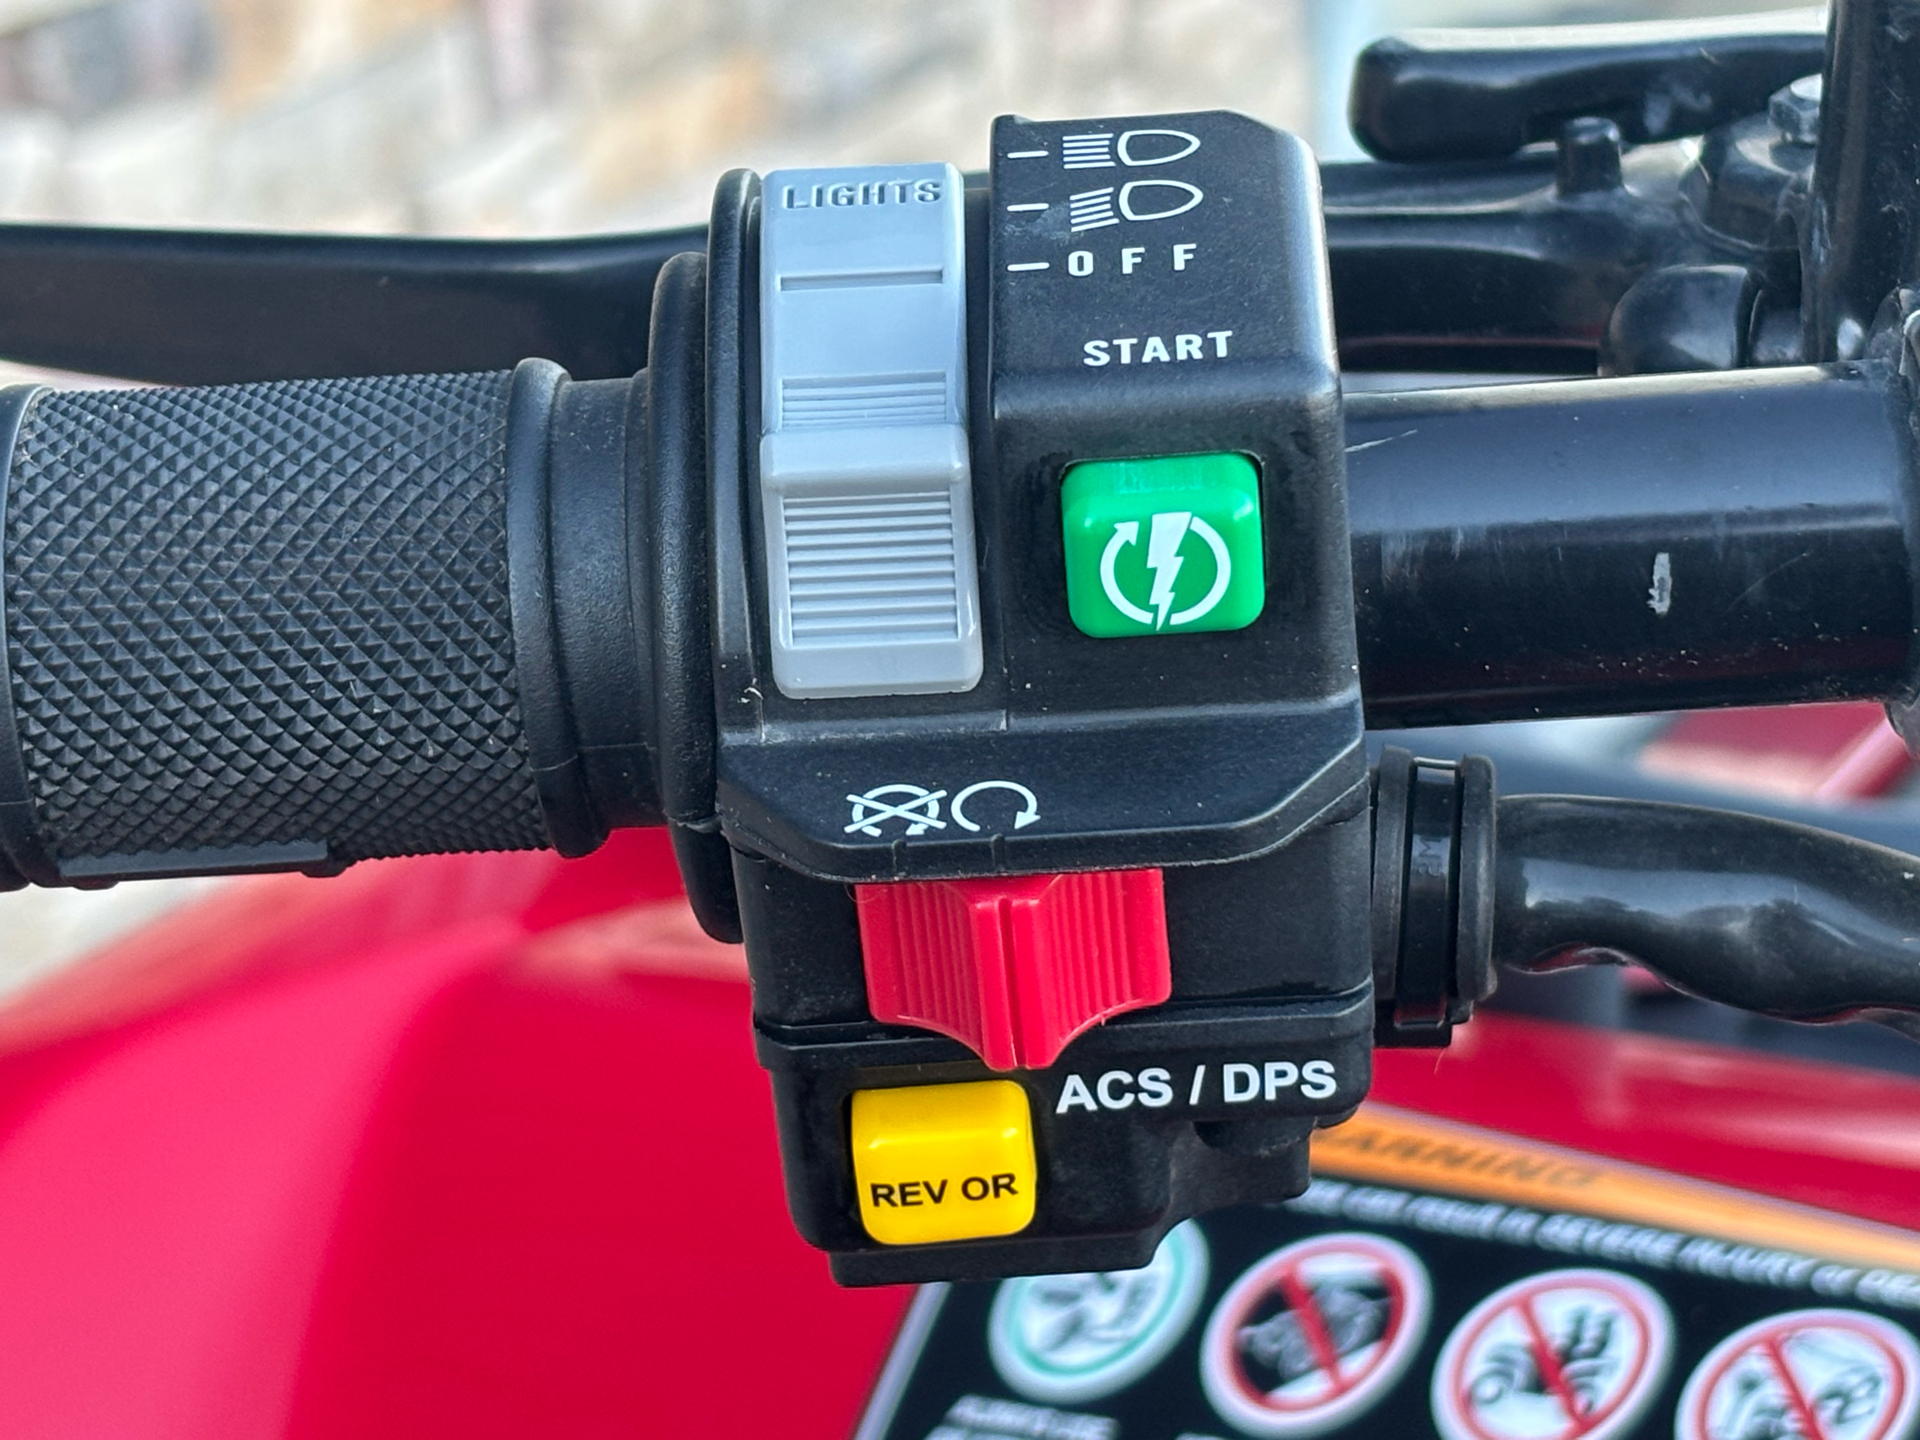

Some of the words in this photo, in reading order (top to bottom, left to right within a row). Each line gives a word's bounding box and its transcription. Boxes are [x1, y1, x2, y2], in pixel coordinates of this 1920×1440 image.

[782, 178, 943, 209] LIGHTS
[1083, 330, 1233, 367] START
[1055, 1067, 1174, 1114] ACS
[1188, 1064, 1206, 1105] /
[1222, 1060, 1337, 1103] DPS
[870, 1179, 949, 1208] REV
[961, 1172, 1019, 1201] OR
